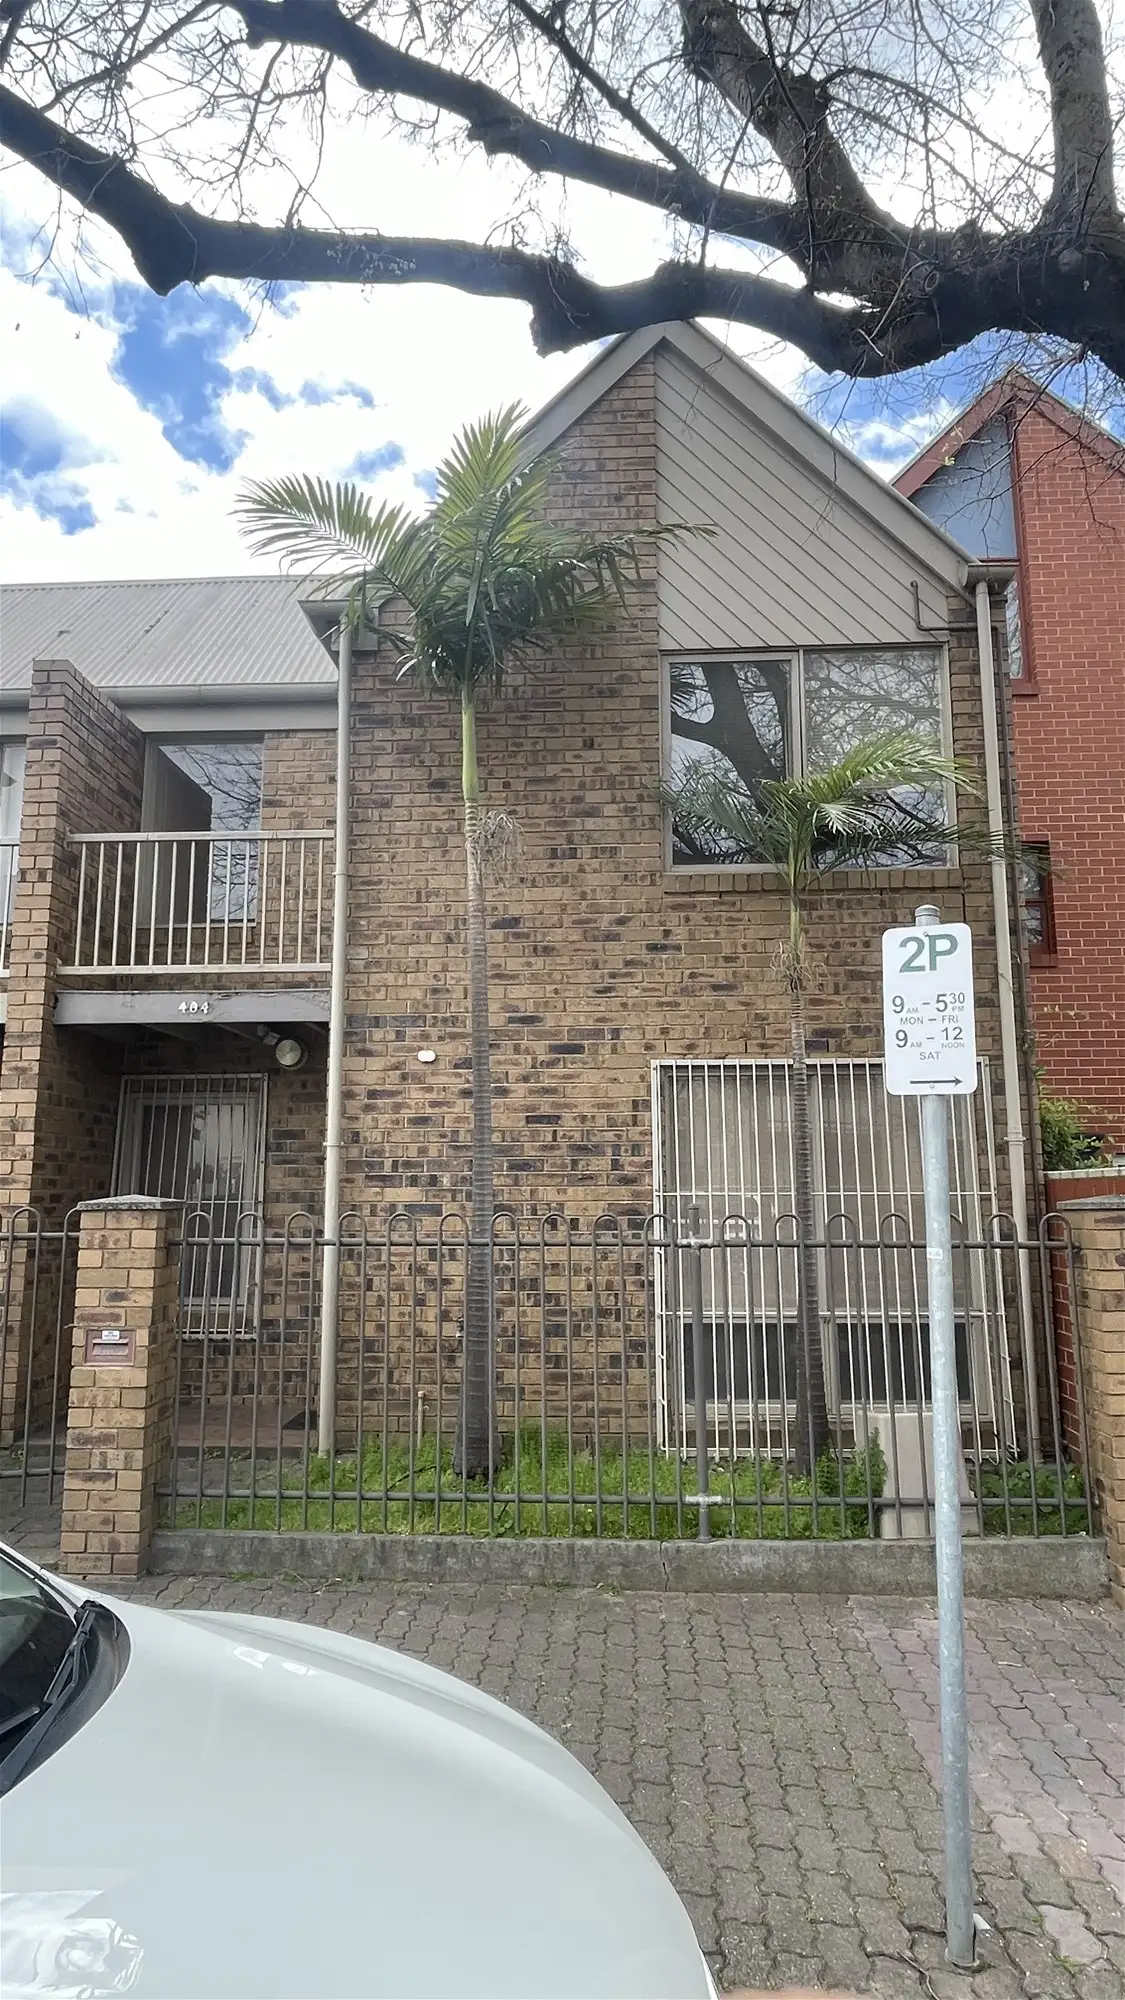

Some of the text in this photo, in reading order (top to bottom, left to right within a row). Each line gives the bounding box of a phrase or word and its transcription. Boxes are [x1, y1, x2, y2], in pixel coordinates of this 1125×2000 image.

[898, 933, 959, 973] 2P
[178, 1001, 209, 1014] 404
[892, 995, 905, 1014] 9
[900, 1016, 924, 1025] MON
[941, 1015, 959, 1024] FRI
[895, 1029, 908, 1048] 9
[941, 1026, 964, 1041] 12
[941, 1041, 965, 1049] NOON
[919, 1051, 941, 1061] SAT
